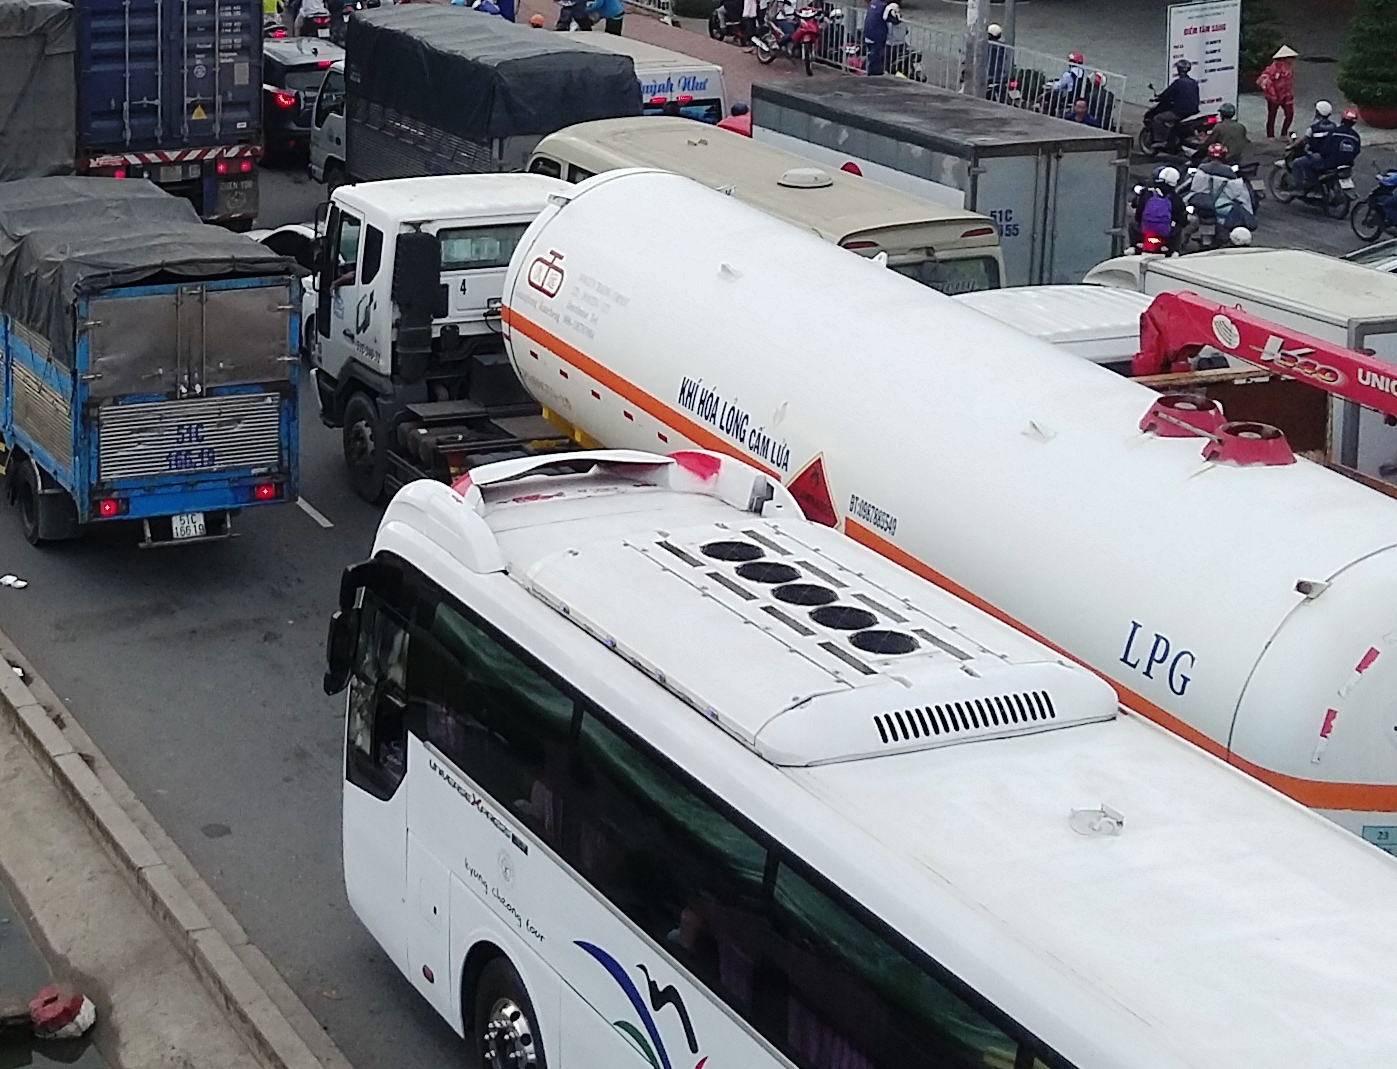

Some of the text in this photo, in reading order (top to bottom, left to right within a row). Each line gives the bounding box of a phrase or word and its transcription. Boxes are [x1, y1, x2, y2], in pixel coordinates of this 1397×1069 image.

[459, 278, 467, 296] 4
[678, 376, 791, 472] KHÍ HÓA LỎNG CẤM LỬA
[179, 514, 197, 525] 51C
[1119, 620, 1196, 696] LPG
[1377, 830, 1389, 840] 23
